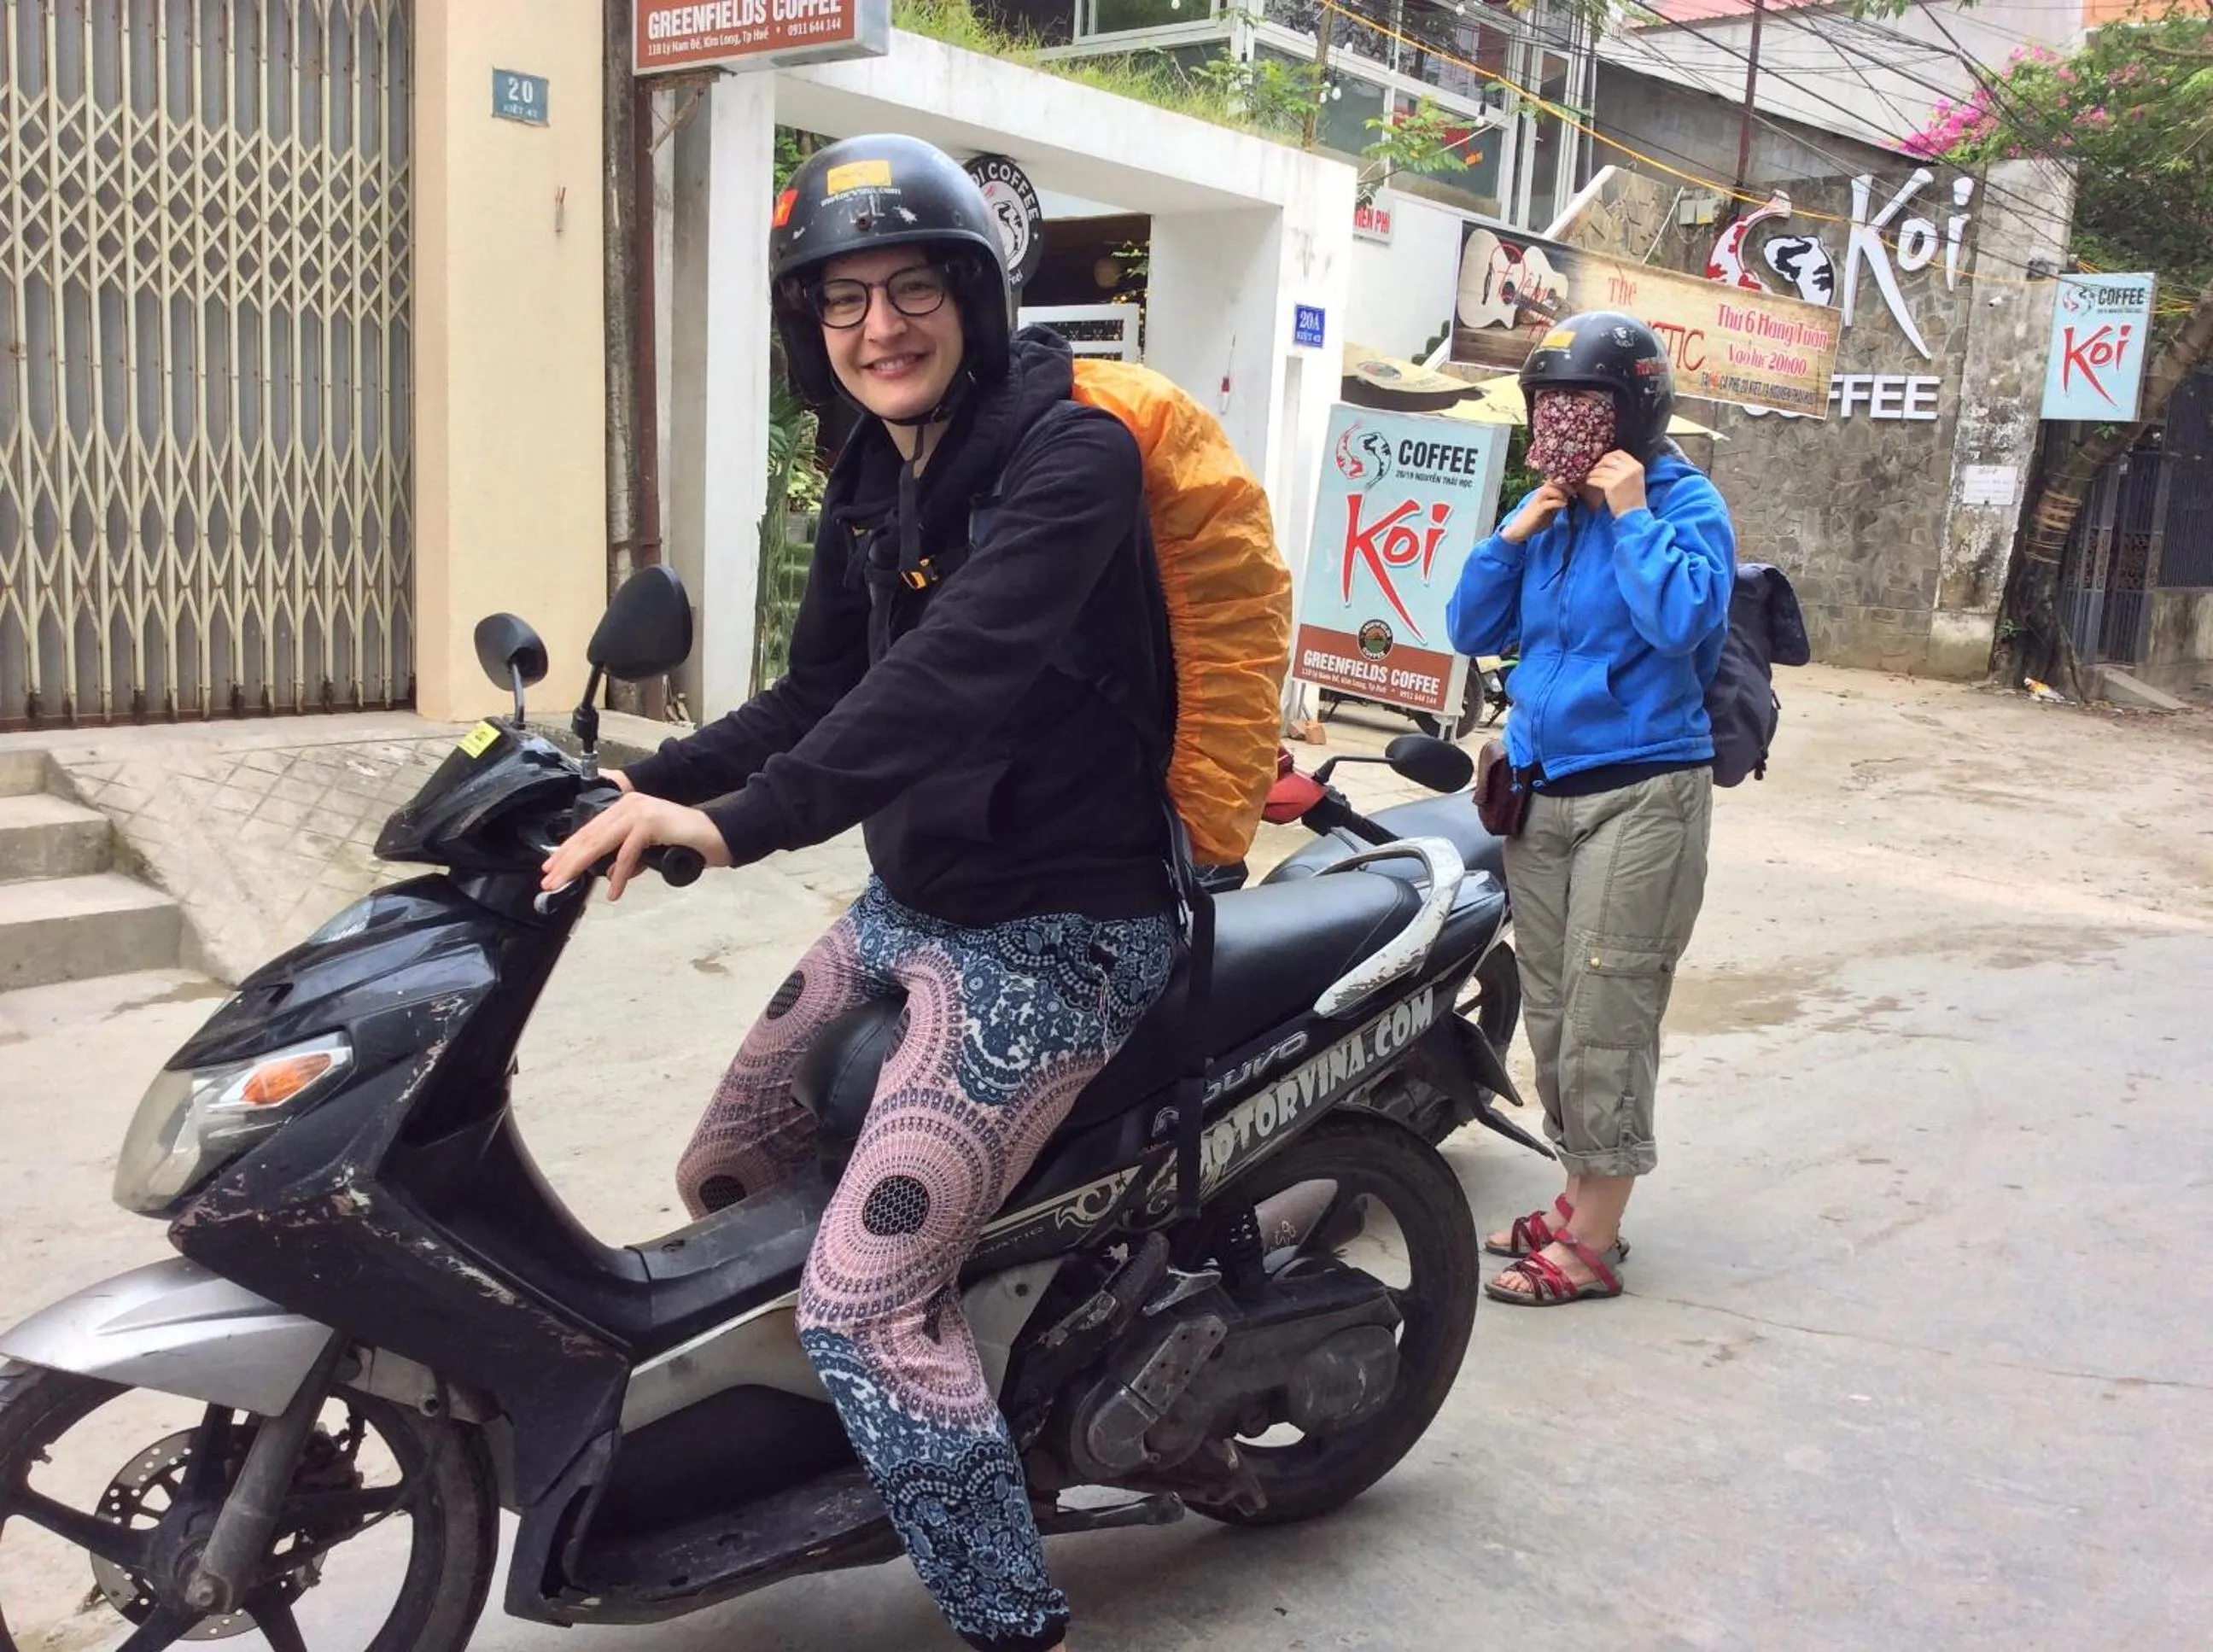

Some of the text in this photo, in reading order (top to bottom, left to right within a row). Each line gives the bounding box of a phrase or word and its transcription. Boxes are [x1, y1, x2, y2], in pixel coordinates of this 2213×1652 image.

[648, 0, 842, 39] GREENFIELDS COFFEE
[809, 20, 825, 32] 644
[508, 77, 533, 103] 20
[988, 162, 1039, 222] COFFEE
[1844, 167, 1974, 359] Koi
[2098, 288, 2146, 305] COFFEE
[1299, 310, 1320, 330] 20A
[1745, 311, 1755, 334] 6
[2064, 324, 2132, 410] Koi
[1830, 374, 1941, 419] FEE
[1398, 439, 1479, 475] COFFEE
[1342, 493, 1451, 644] Koi
[1304, 650, 1440, 696] GREENFIELDS COFFEE
